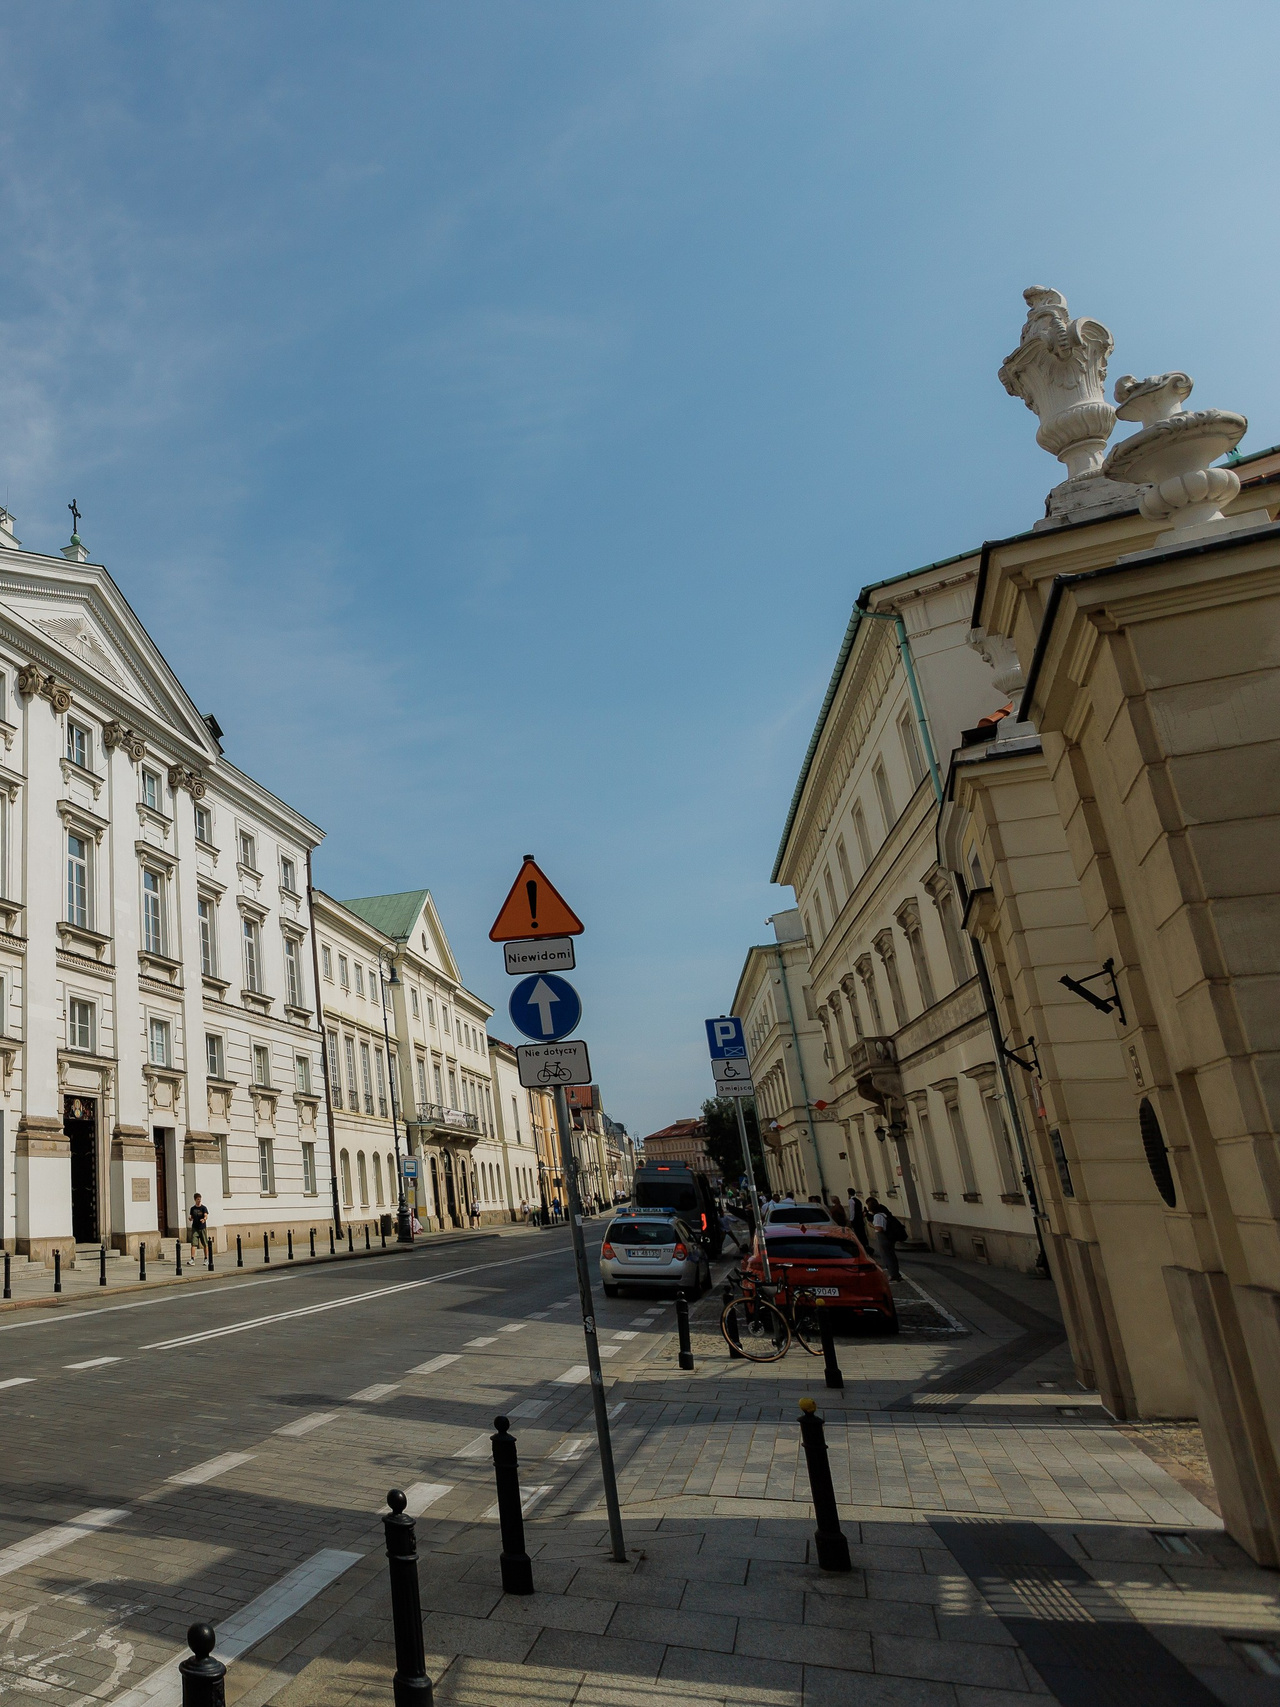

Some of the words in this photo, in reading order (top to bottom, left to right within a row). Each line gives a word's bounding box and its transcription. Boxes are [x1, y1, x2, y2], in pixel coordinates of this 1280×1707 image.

[508, 949, 571, 964] Niewidomi
[714, 1021, 736, 1047] P
[525, 1049, 540, 1058] Nie
[543, 1046, 577, 1057] dotyczy
